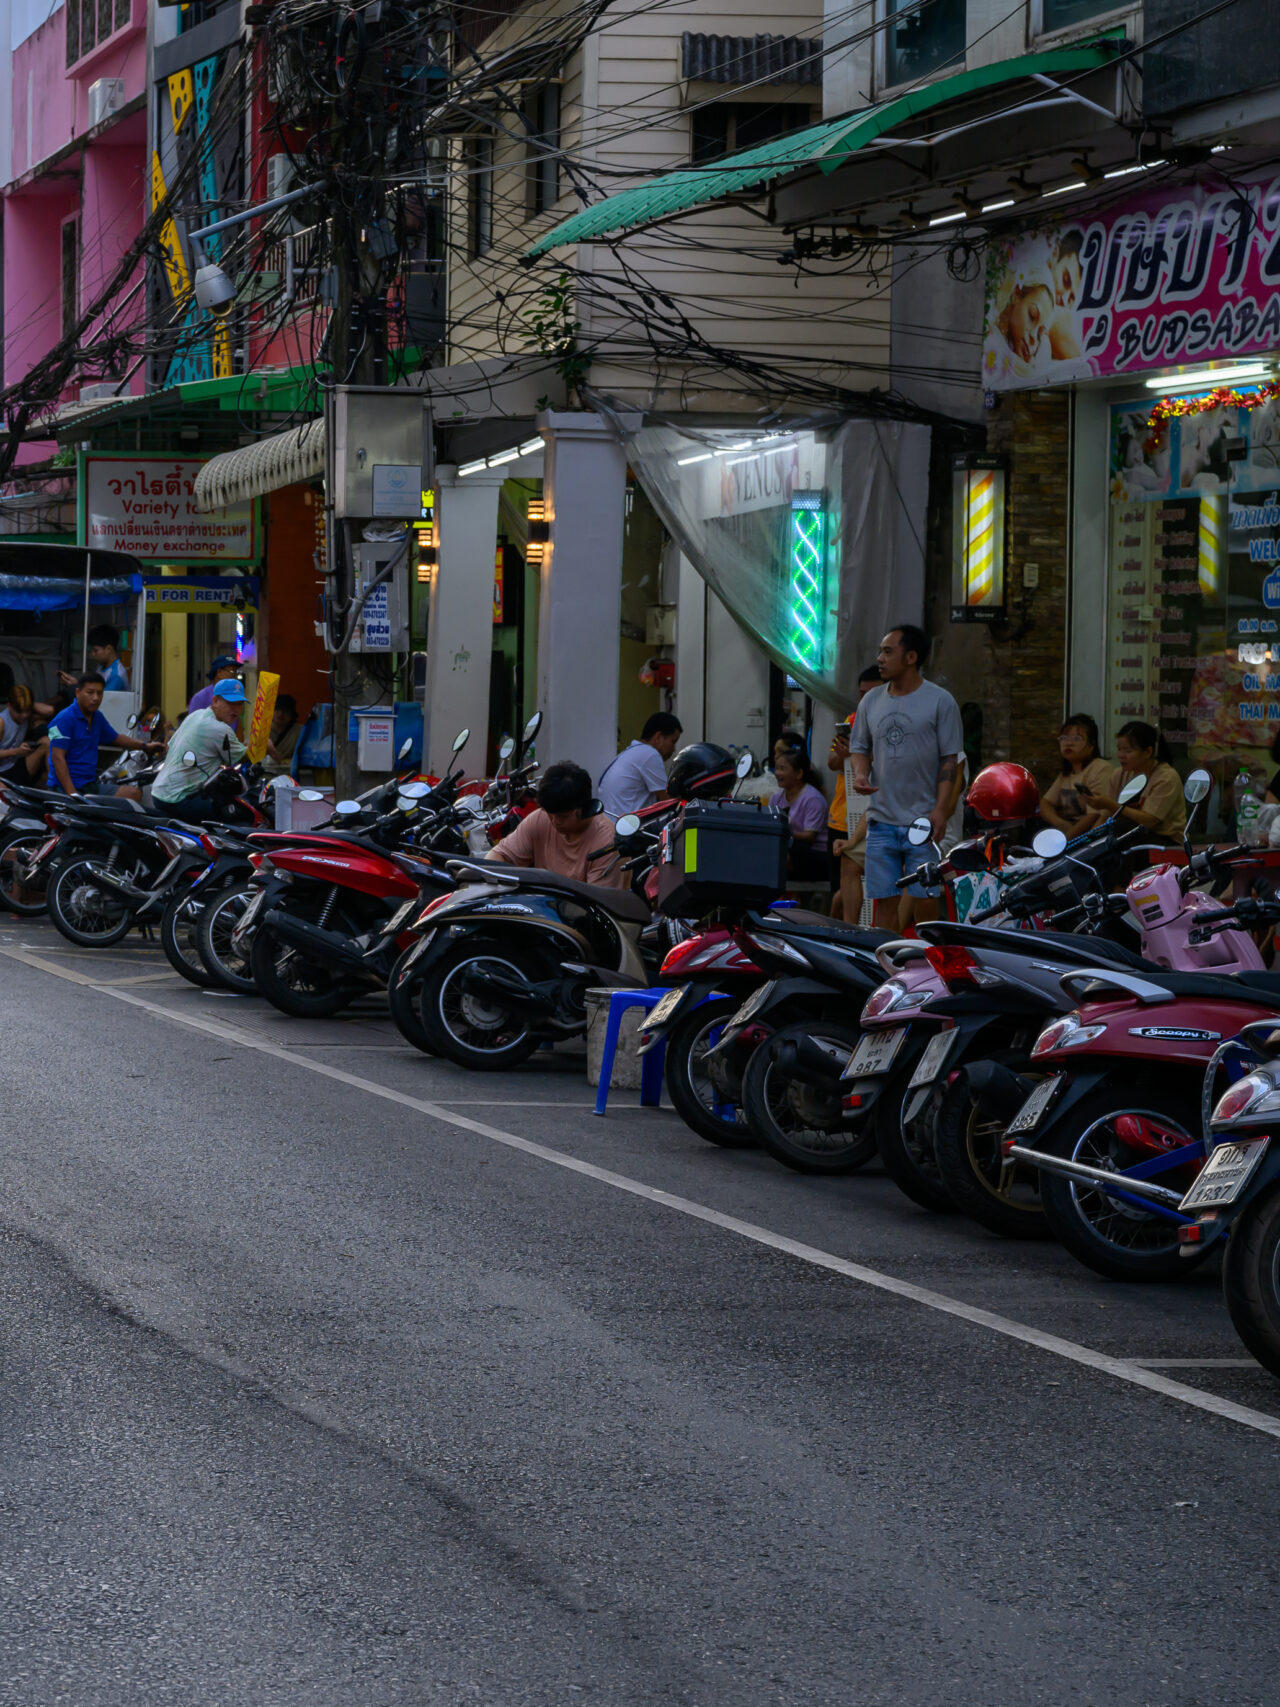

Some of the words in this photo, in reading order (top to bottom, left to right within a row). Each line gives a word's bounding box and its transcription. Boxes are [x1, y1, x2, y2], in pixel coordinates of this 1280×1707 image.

[734, 452, 783, 505] VENUS
[122, 500, 179, 519] Variety
[114, 540, 158, 554] Money
[163, 540, 225, 555] exchange
[162, 589, 189, 601] FOR
[195, 589, 230, 601] RENT
[1244, 674, 1260, 690] OIL
[1240, 703, 1264, 719] THAI
[1145, 1028, 1200, 1039] Scoopy
[856, 1059, 882, 1075] 987
[1195, 1184, 1235, 1202] 1837
